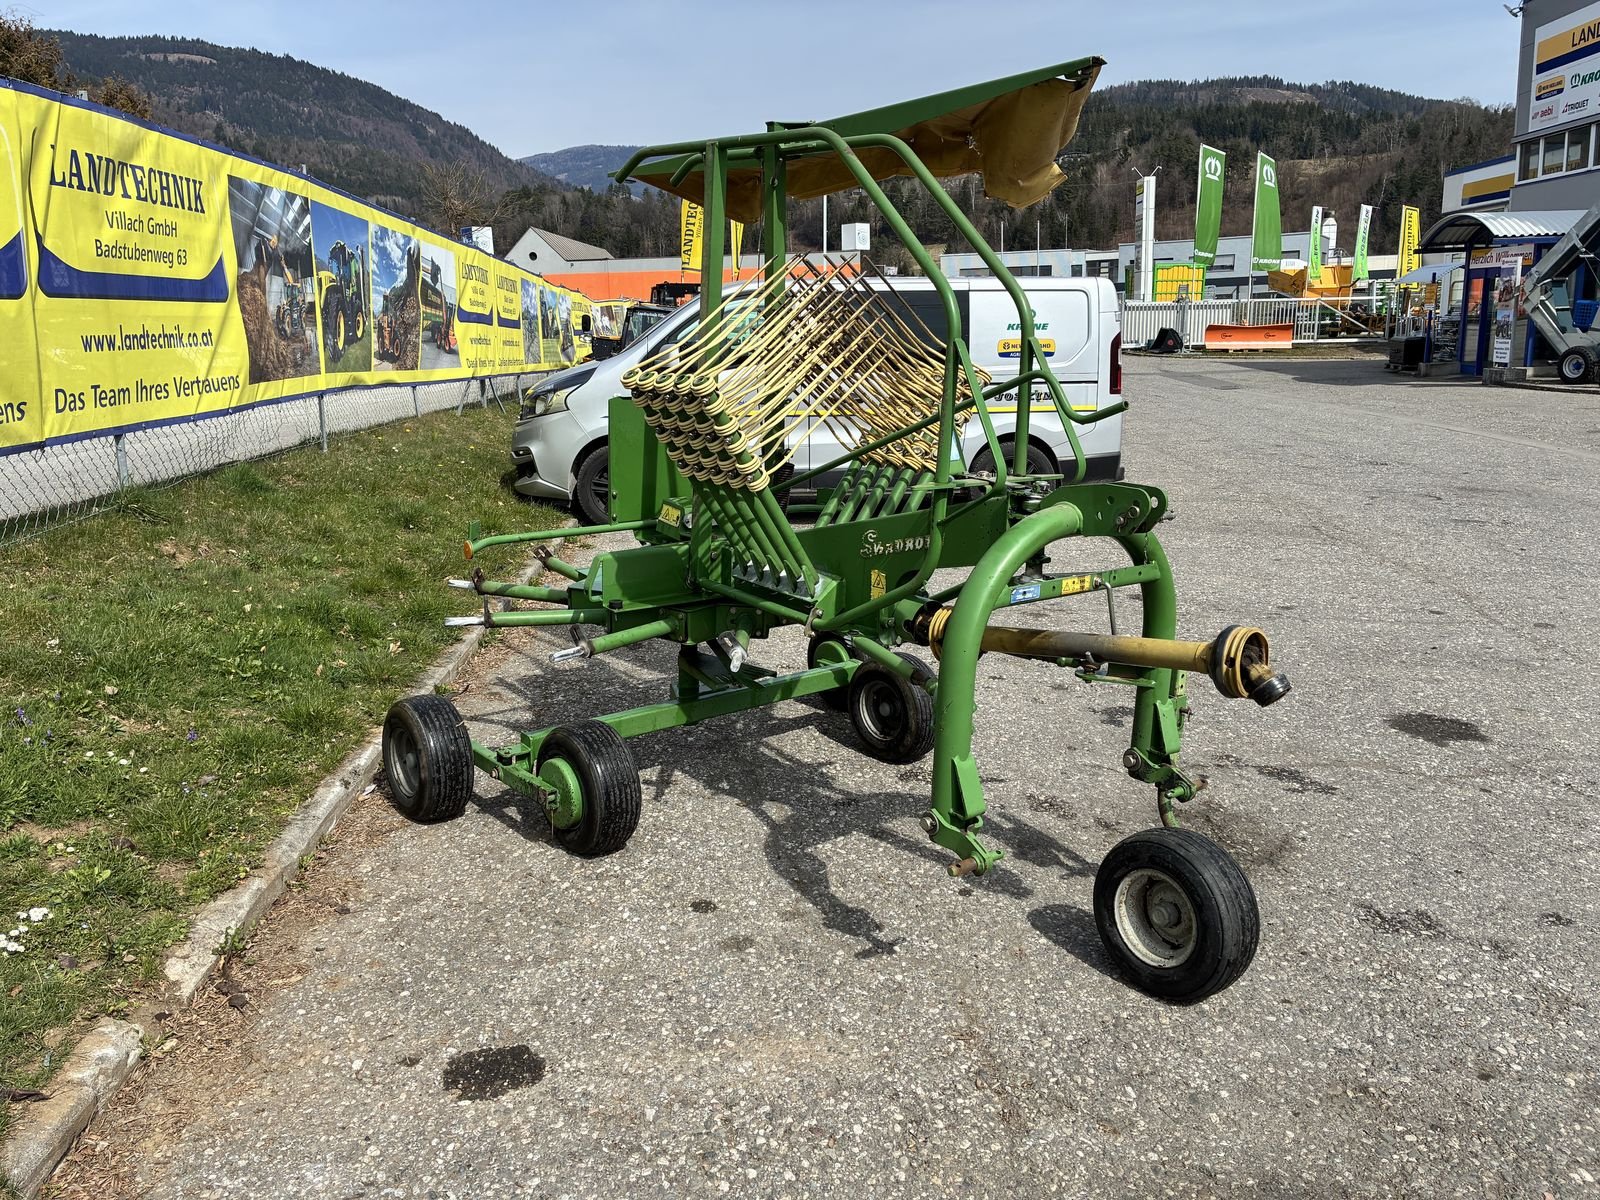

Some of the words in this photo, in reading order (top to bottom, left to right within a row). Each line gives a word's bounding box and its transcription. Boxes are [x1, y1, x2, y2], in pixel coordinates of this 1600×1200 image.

[1540, 105, 1553, 118] aebi
[1568, 99, 1589, 112] TRIQUET
[50, 144, 206, 214] LANDTECHNIK
[105, 210, 144, 233] Villach
[147, 217, 178, 238] GmbH
[94, 239, 174, 268] Badstubenweg
[177, 248, 188, 265] 63
[81, 324, 213, 353] www.landtechnik.co.at
[54, 388, 85, 414] Das
[90, 384, 131, 409] Team
[135, 379, 169, 404] Ihres
[173, 374, 240, 402] Vertrauens
